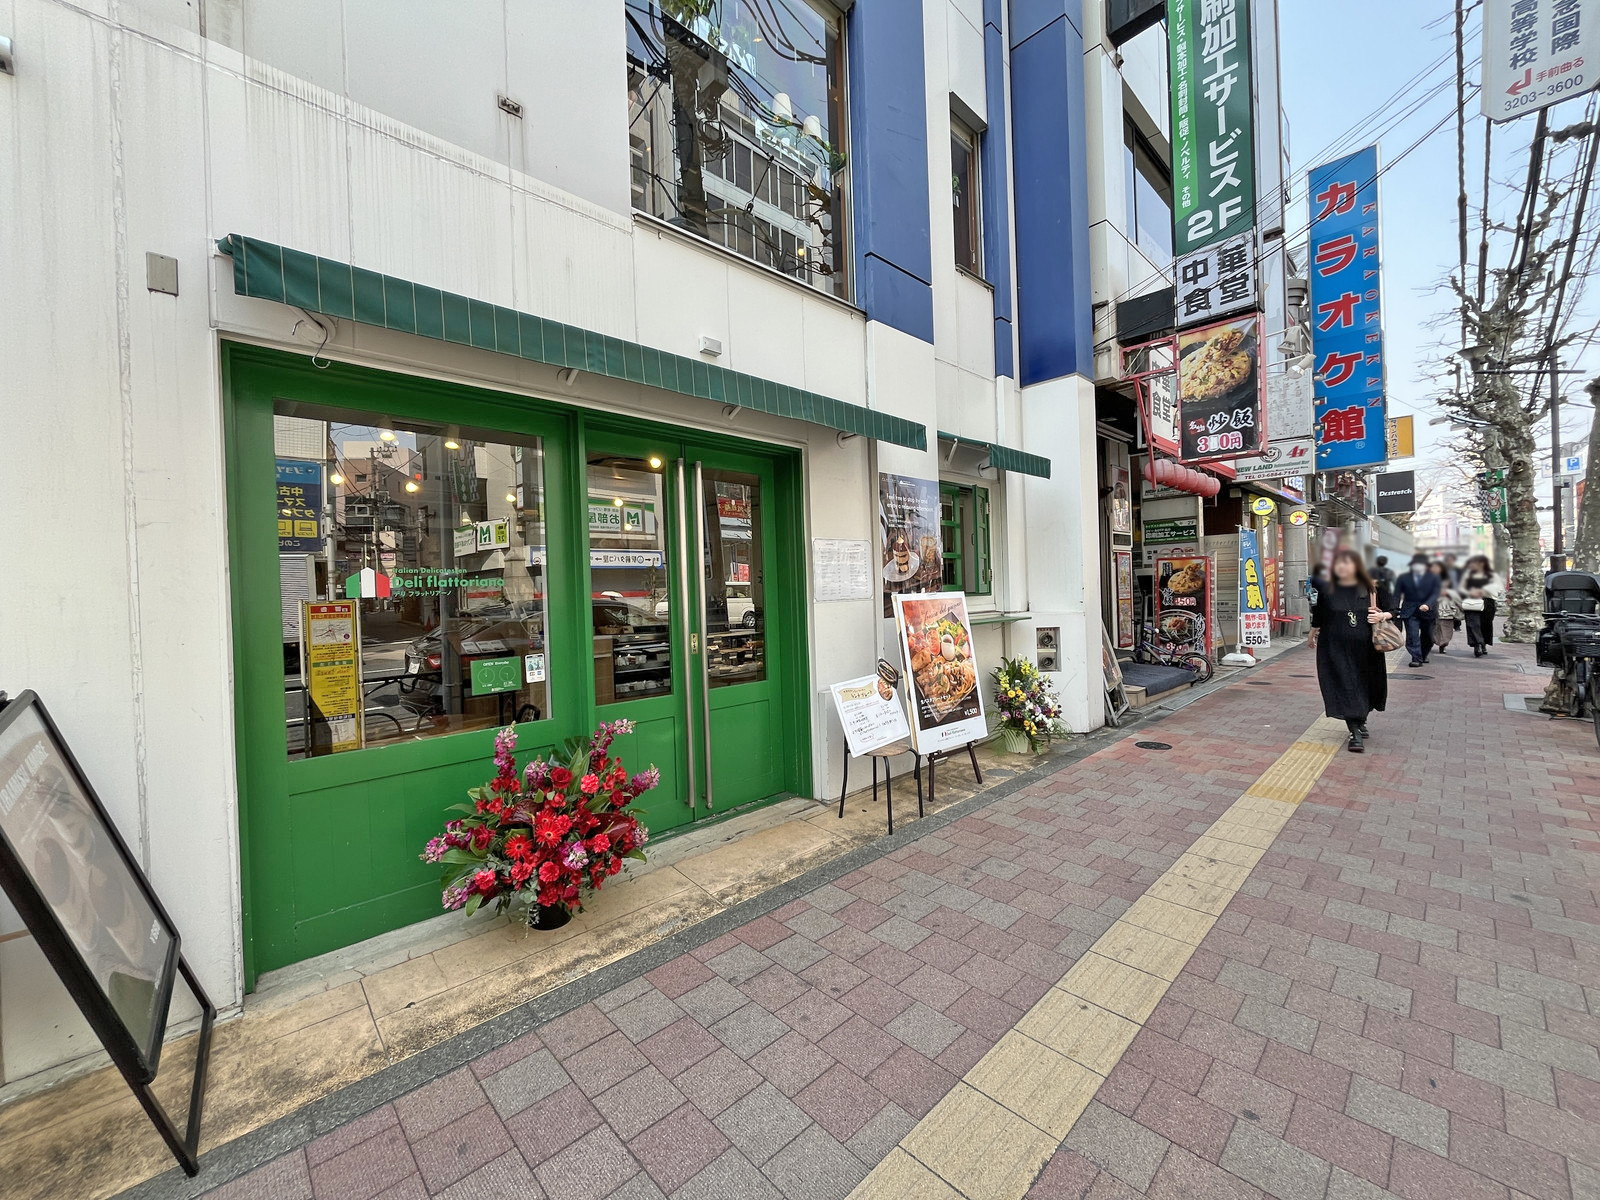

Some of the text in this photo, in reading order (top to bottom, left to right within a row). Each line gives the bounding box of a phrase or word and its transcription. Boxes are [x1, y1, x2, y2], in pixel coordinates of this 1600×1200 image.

[1509, 0, 1539, 71] 高等学校
[1536, 56, 1585, 83] 手前曲る
[1504, 74, 1584, 112] 3203-3600
[1187, 195, 1242, 242] 2F
[1182, 242, 1249, 286] 中華
[1184, 272, 1250, 317] 食堂
[1315, 180, 1367, 445] カラオケ館
[1207, 407, 1254, 433] 炒飯
[1197, 431, 1243, 453] 30円
[1253, 463, 1273, 471] LAND
[393, 575, 505, 589] Deli flattoriano
[393, 589, 453, 598] デリ フラットリアーノ
